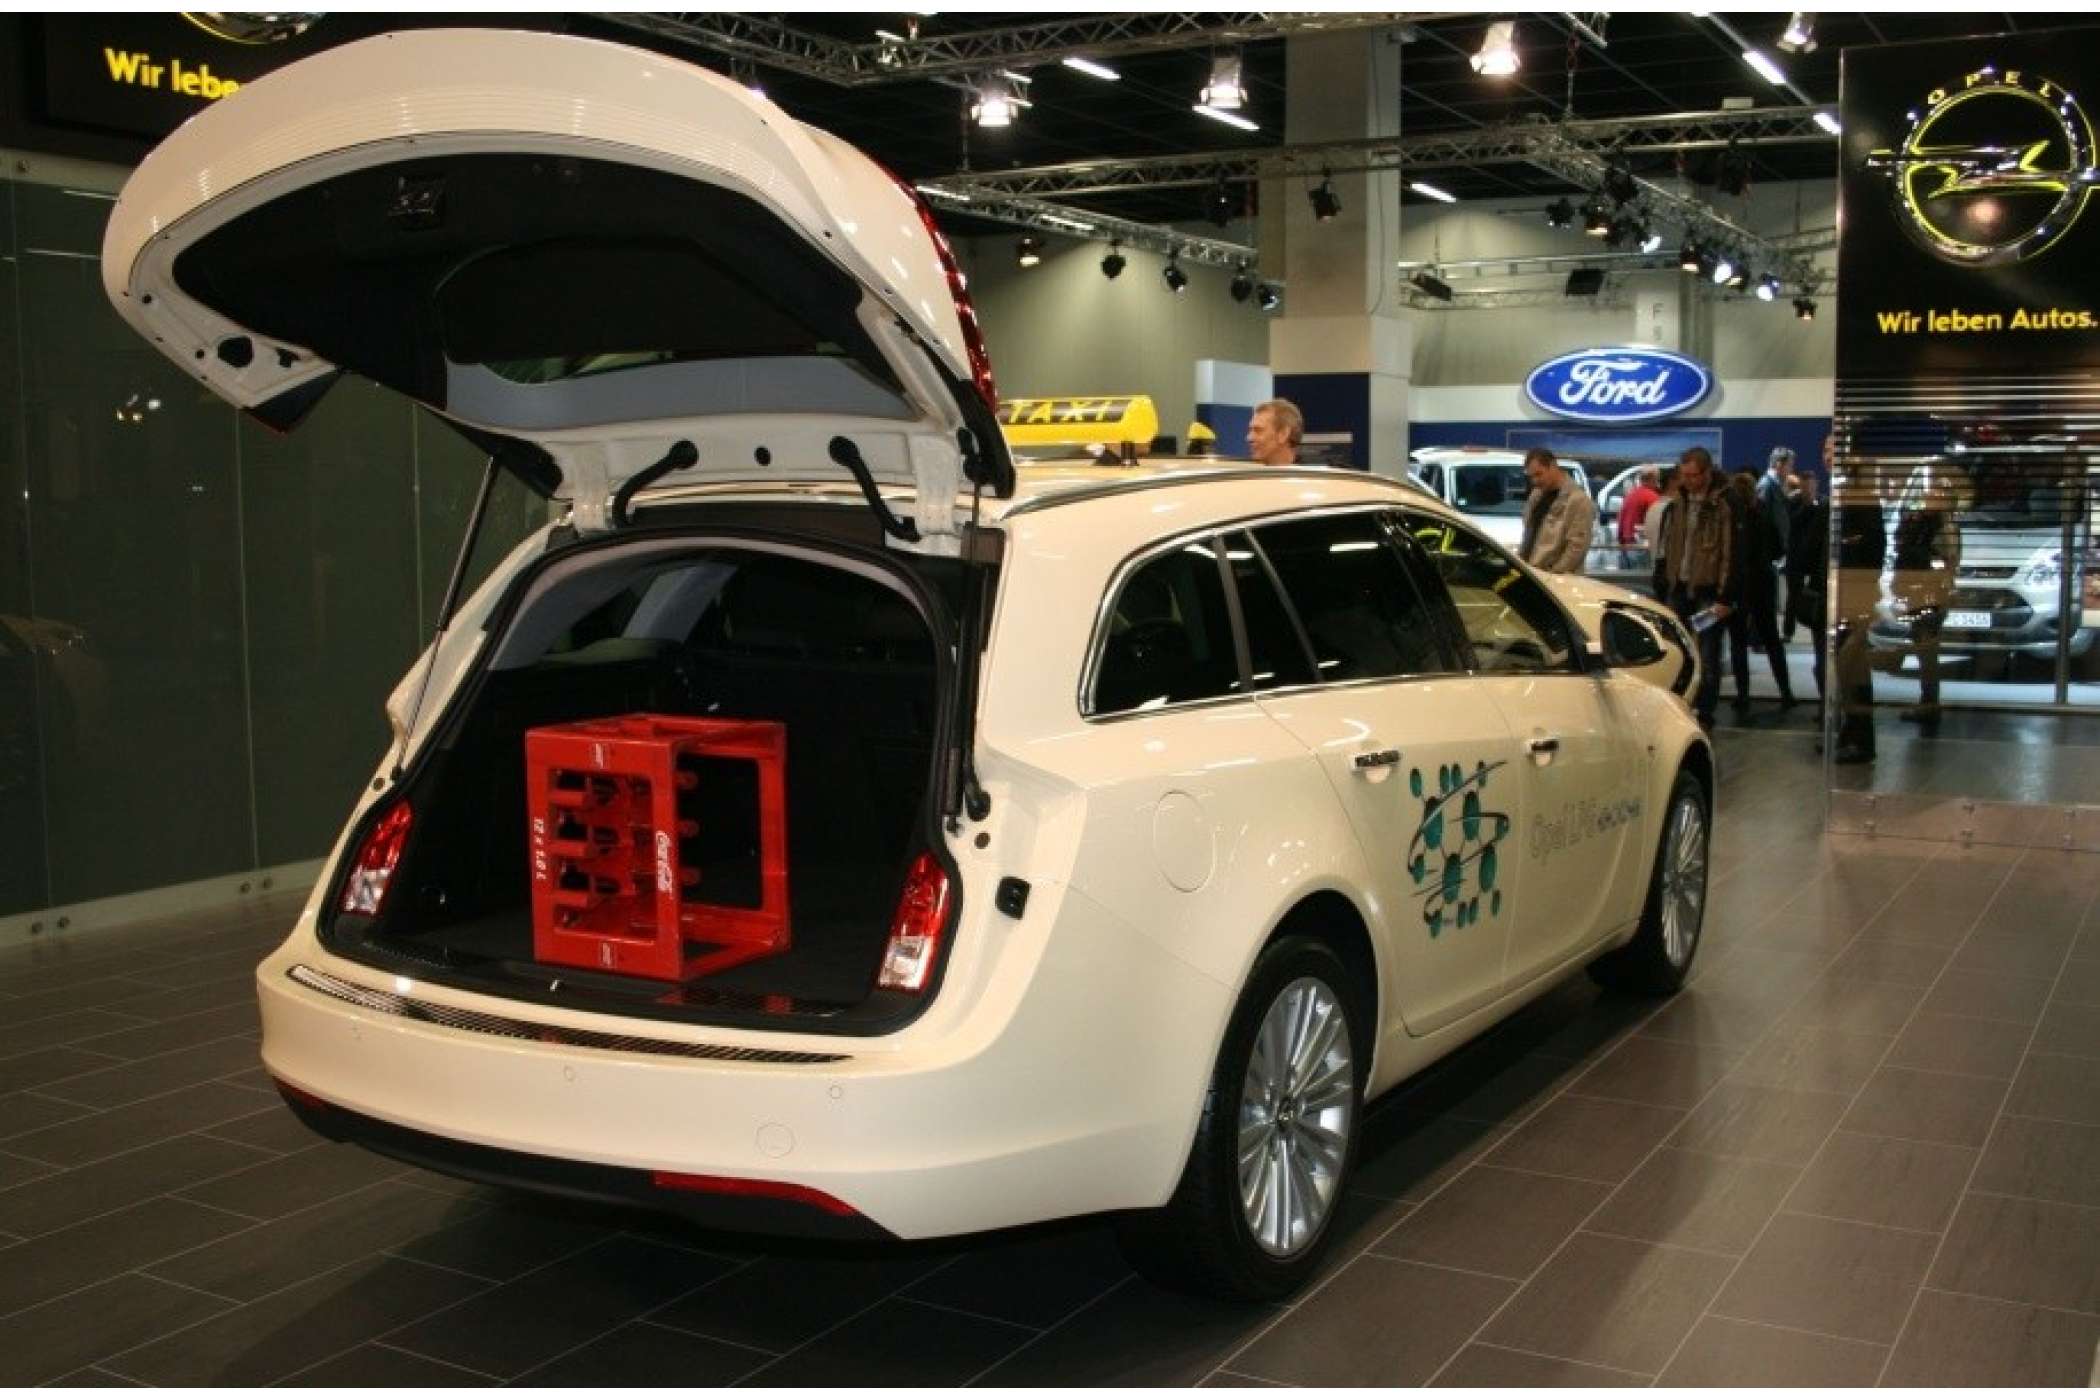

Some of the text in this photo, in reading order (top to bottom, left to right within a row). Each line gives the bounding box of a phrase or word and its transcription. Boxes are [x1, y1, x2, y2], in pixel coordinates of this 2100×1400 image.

[104, 48, 165, 88] Wir
[1877, 307, 2099, 334] Wir leben Autos.
[1559, 359, 1671, 405] Ford
[1009, 398, 1113, 424] TAXI
